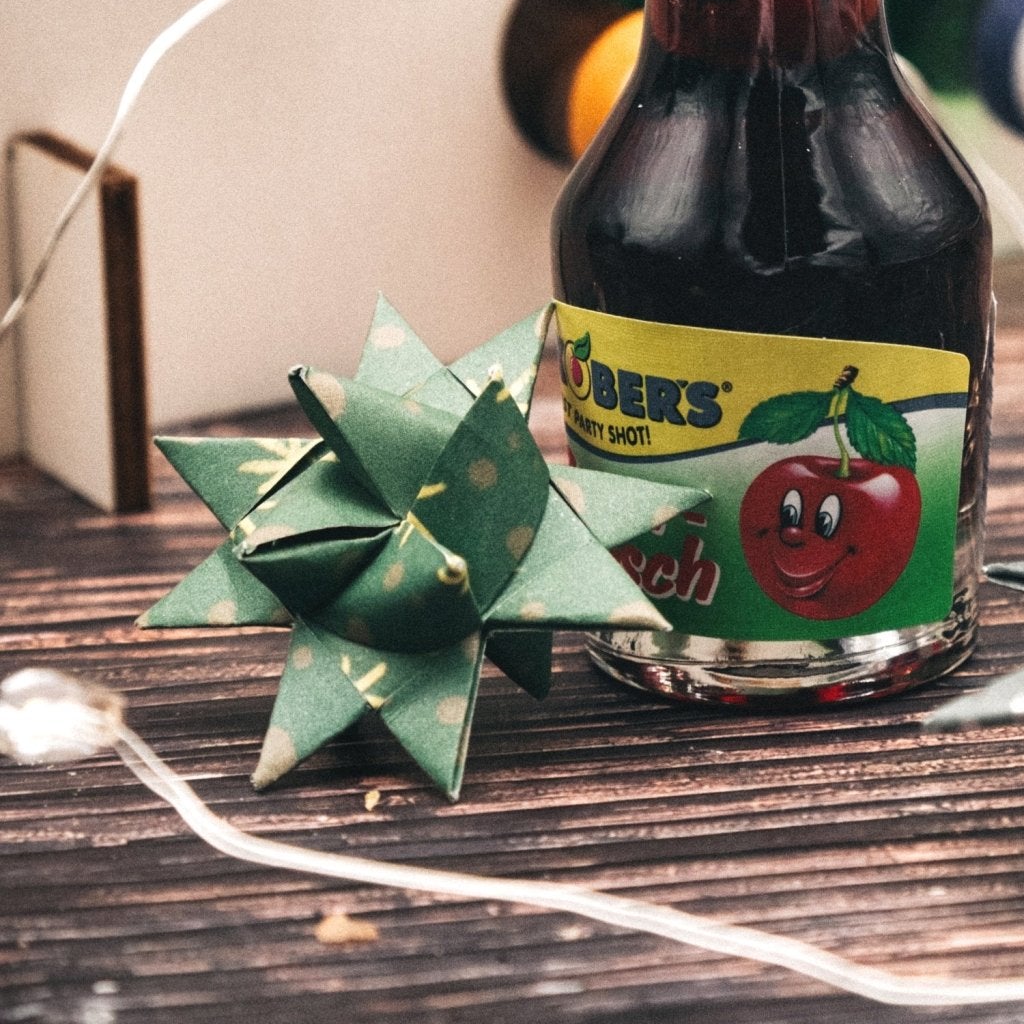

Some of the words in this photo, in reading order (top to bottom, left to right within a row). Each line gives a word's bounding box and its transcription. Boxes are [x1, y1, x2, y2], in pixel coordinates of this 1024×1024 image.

[573, 409, 604, 441] PARTY
[608, 424, 652, 447] SHOT!
[609, 533, 721, 606] sch
